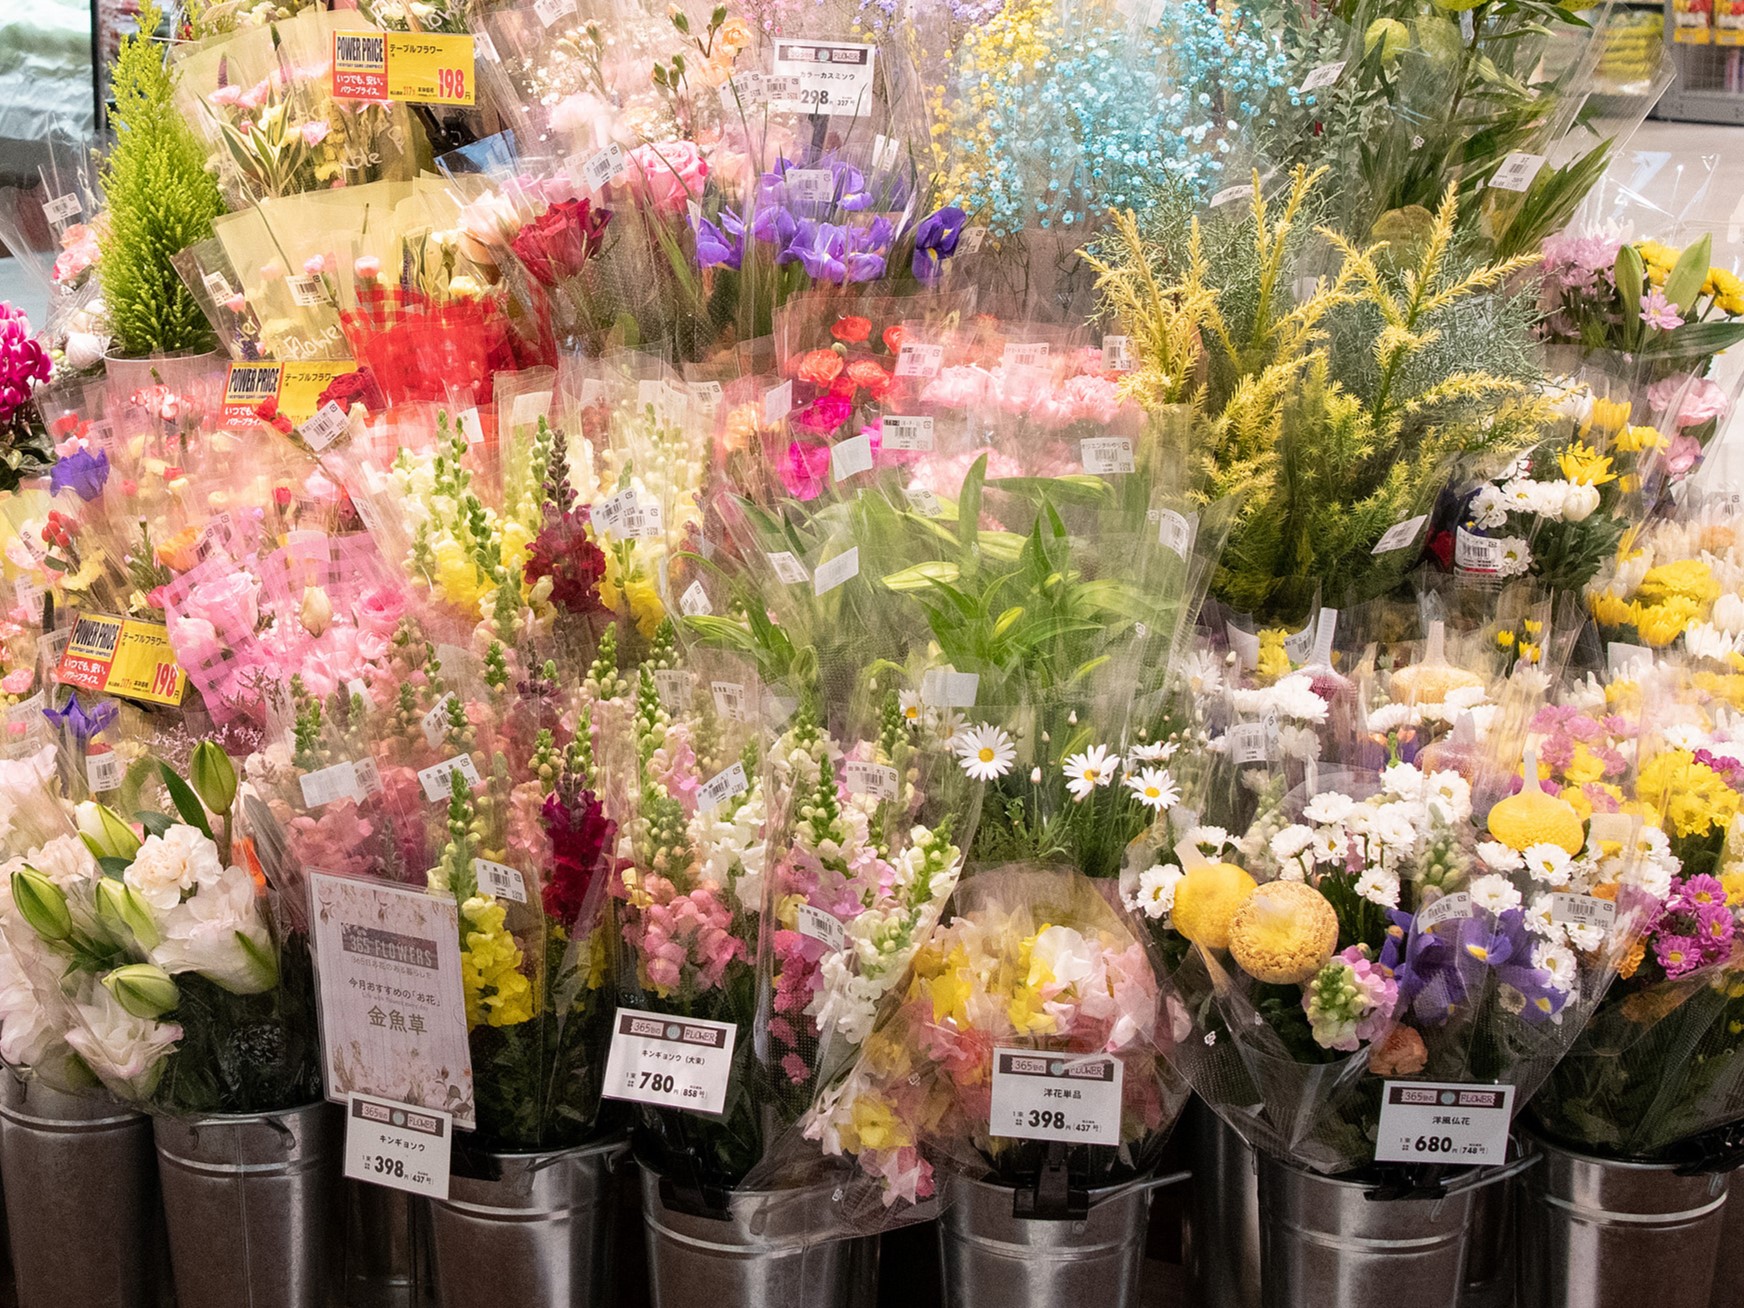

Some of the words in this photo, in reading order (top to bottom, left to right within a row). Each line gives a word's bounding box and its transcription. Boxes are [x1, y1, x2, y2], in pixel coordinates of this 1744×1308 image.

[337, 37, 361, 61] POWER
[362, 38, 383, 62] PRICE
[390, 44, 443, 54] テーブルフラワー
[229, 368, 257, 393] POWER
[257, 368, 280, 393] PRICE
[71, 619, 100, 647] POWER
[95, 623, 119, 650] PRICE
[122, 632, 168, 647] テーブルフラワー
[349, 934, 370, 954] 365
[374, 939, 433, 967] FLOWERS
[367, 1005, 428, 1036] 金魚草
[685, 1028, 716, 1043] FLOWER
[1043, 1088, 1082, 1099] 洋花単品
[1460, 1094, 1494, 1104] FLOWER
[408, 1114, 436, 1131] FLOWER
[1432, 1116, 1471, 1126] 洋風仏花
[380, 1134, 426, 1152] キンギョソウ
